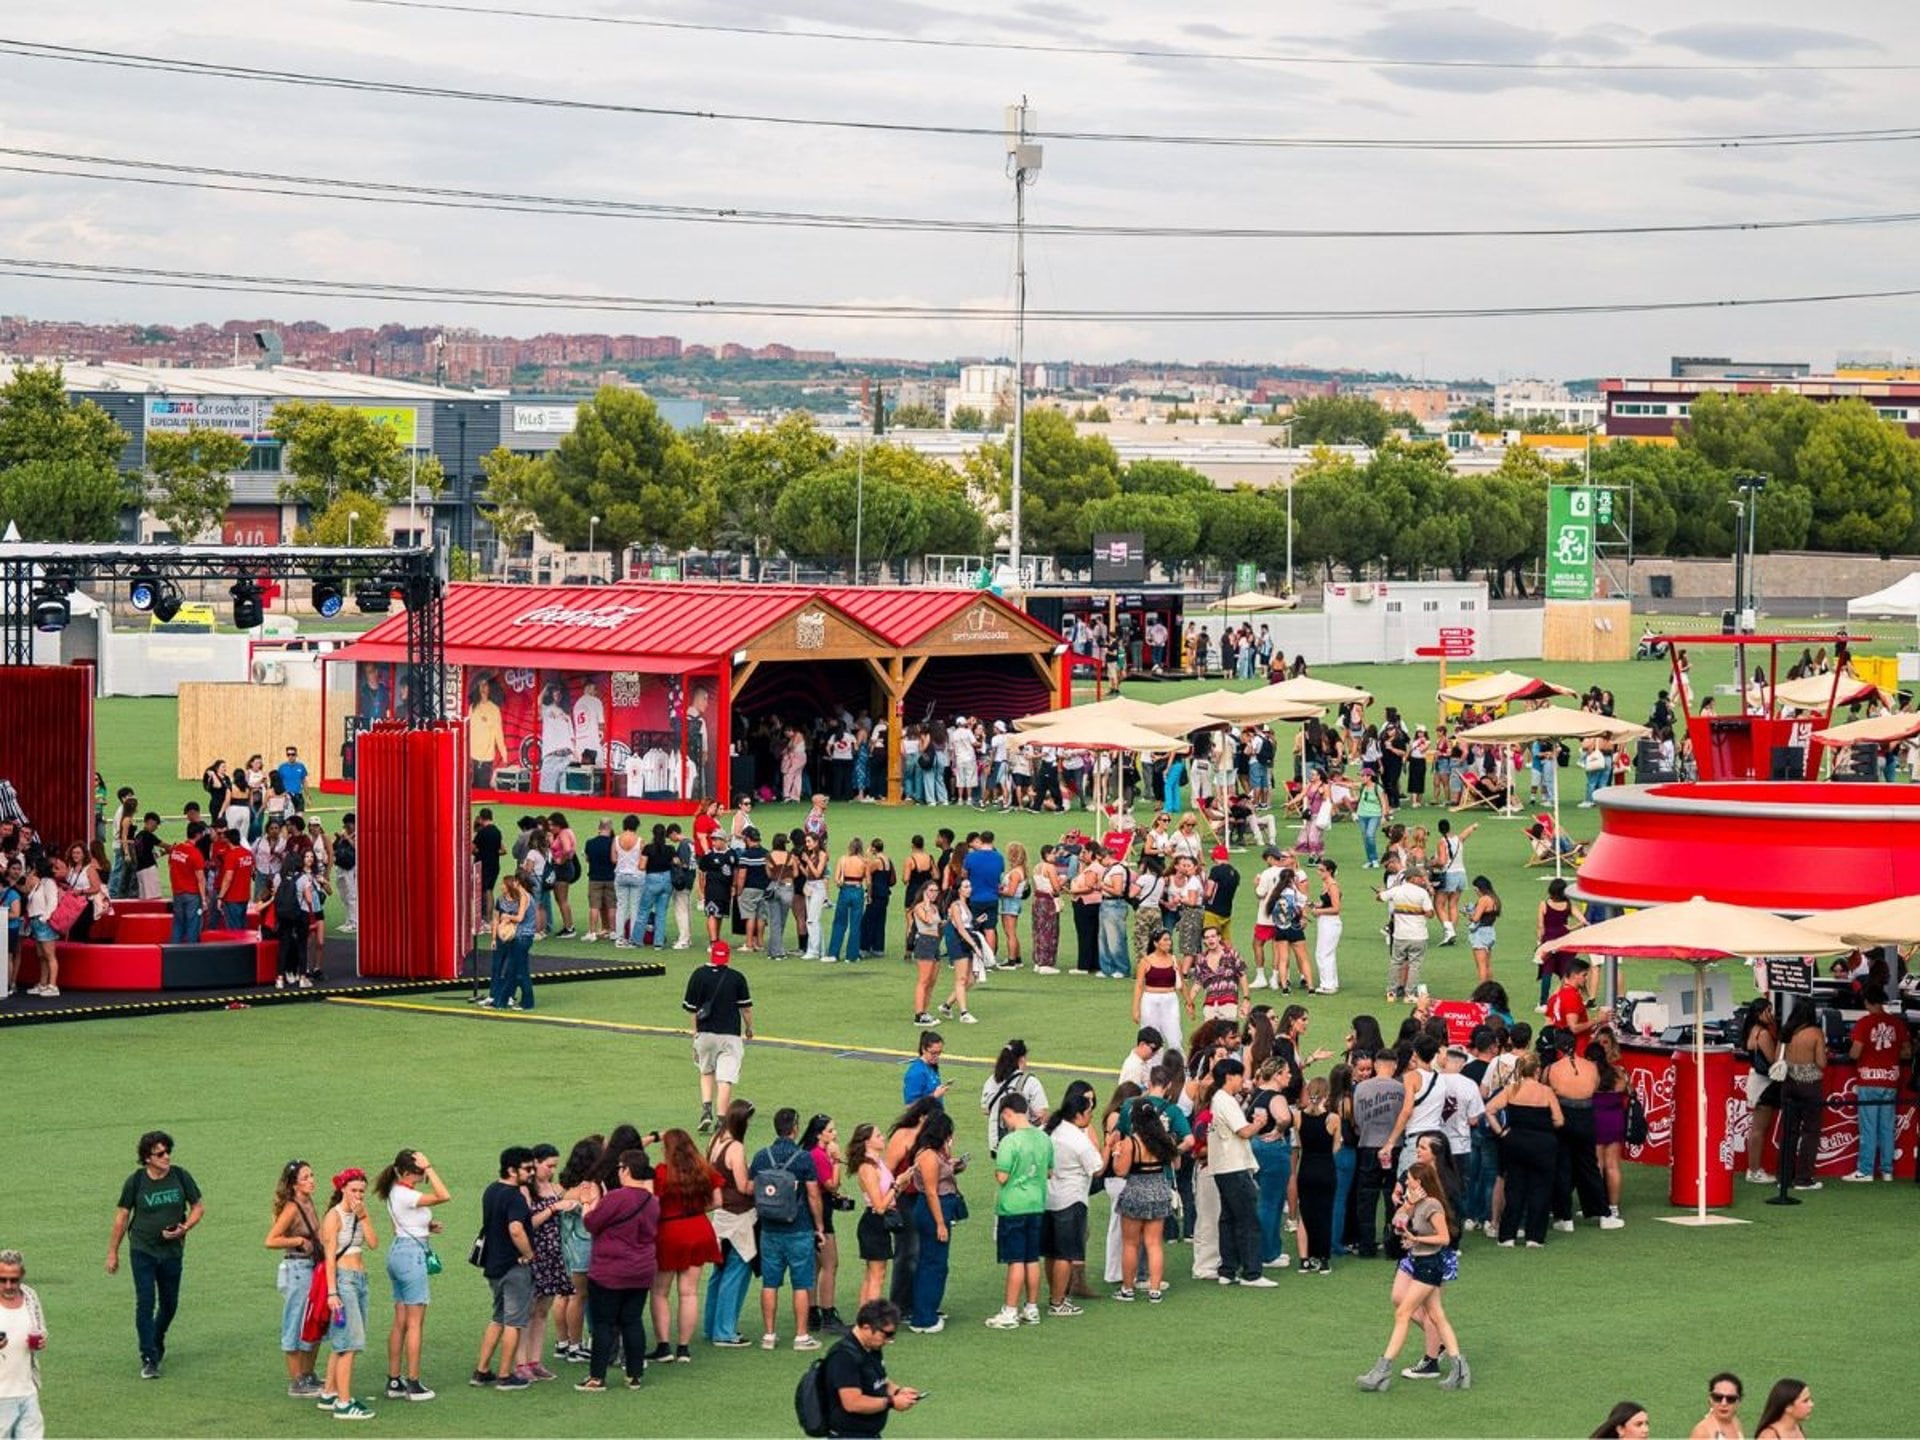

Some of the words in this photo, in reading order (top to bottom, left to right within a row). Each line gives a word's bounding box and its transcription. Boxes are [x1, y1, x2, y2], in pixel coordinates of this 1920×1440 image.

[196, 404, 212, 415] Car
[215, 402, 250, 415] service
[1576, 496, 1585, 511] 6
